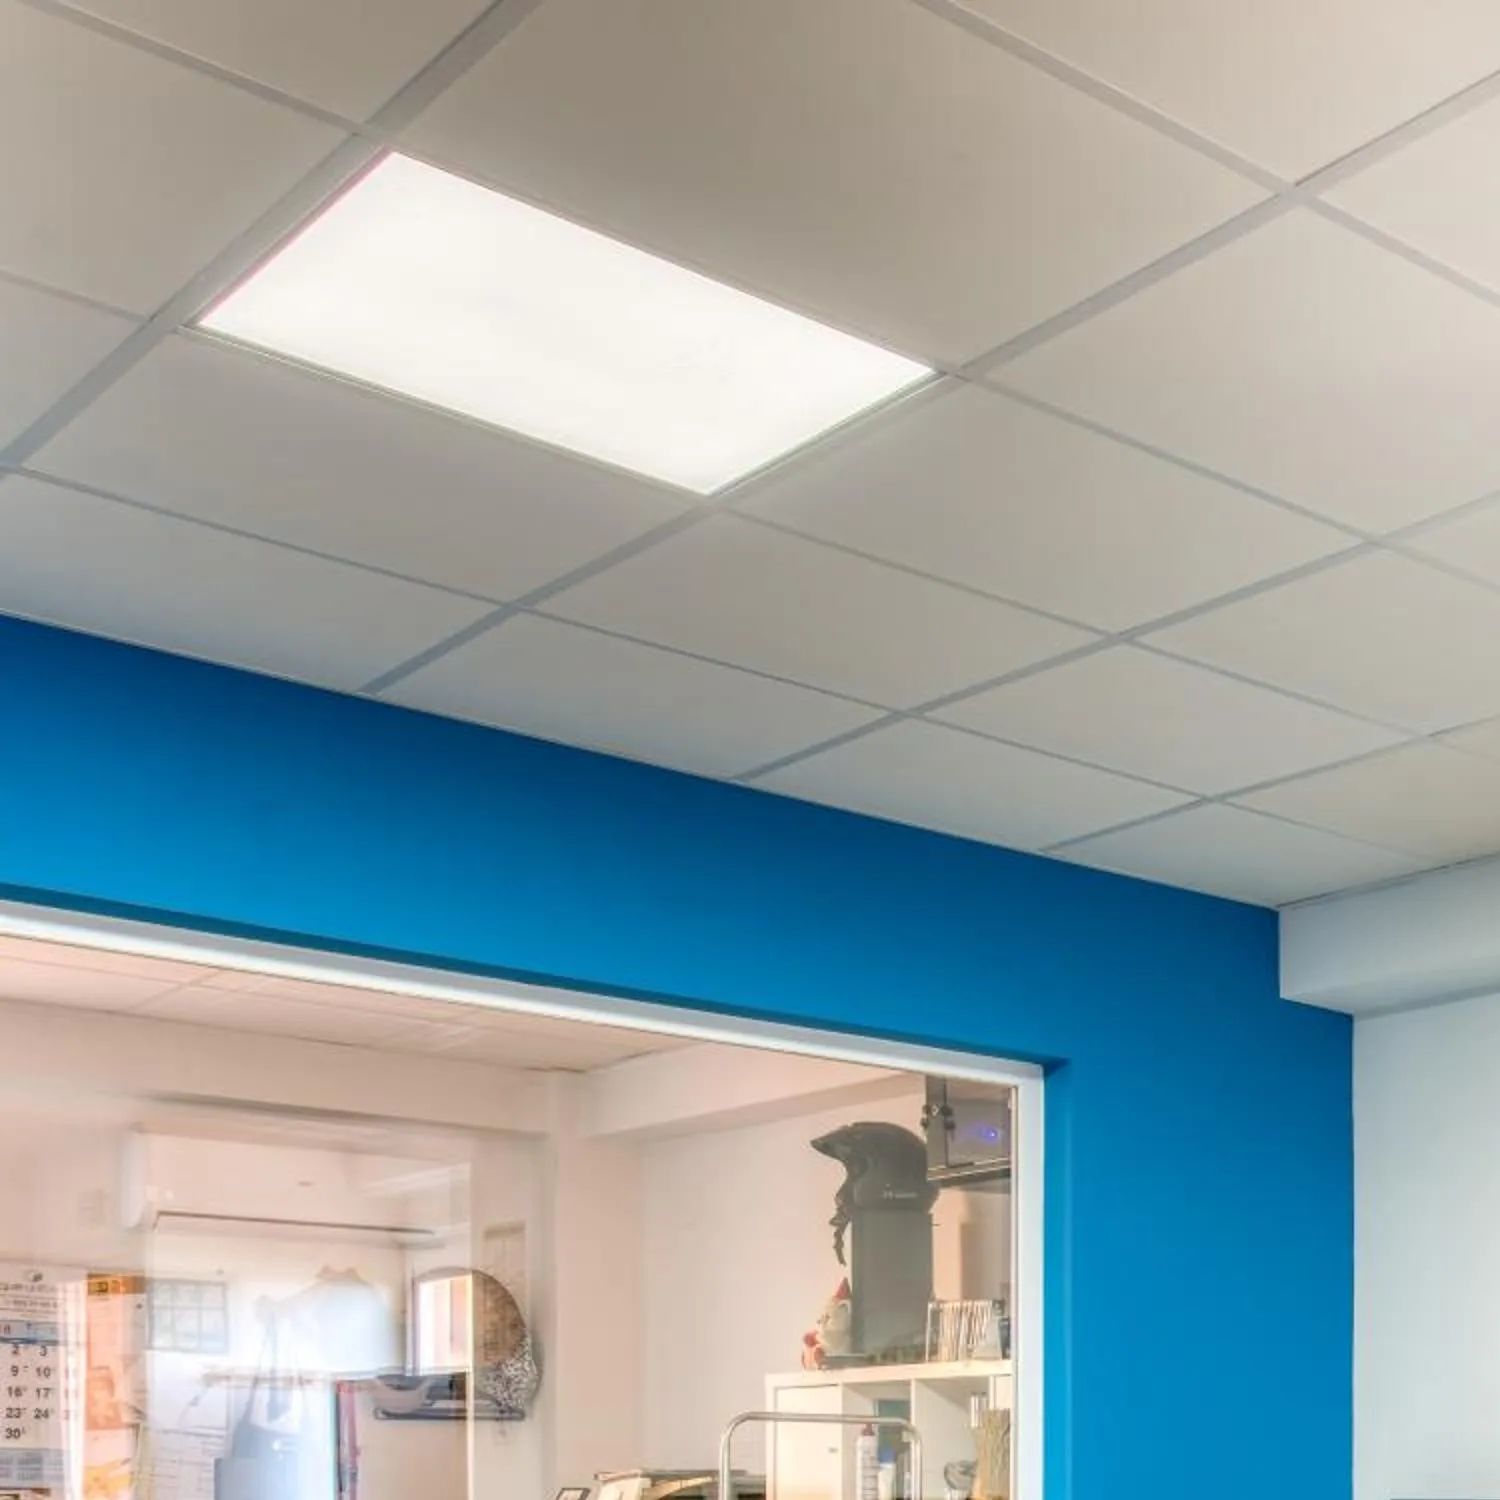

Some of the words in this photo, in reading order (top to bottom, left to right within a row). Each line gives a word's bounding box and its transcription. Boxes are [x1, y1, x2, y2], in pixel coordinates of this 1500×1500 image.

[39, 1345, 48, 1357] 3
[10, 1365, 19, 1377] 9
[36, 1366, 51, 1378] 10
[7, 1385, 23, 1397] 16
[36, 1387, 51, 1399] 17
[5, 1407, 21, 1419] 23
[34, 1407, 49, 1419] 24
[5, 1427, 21, 1439] 30
